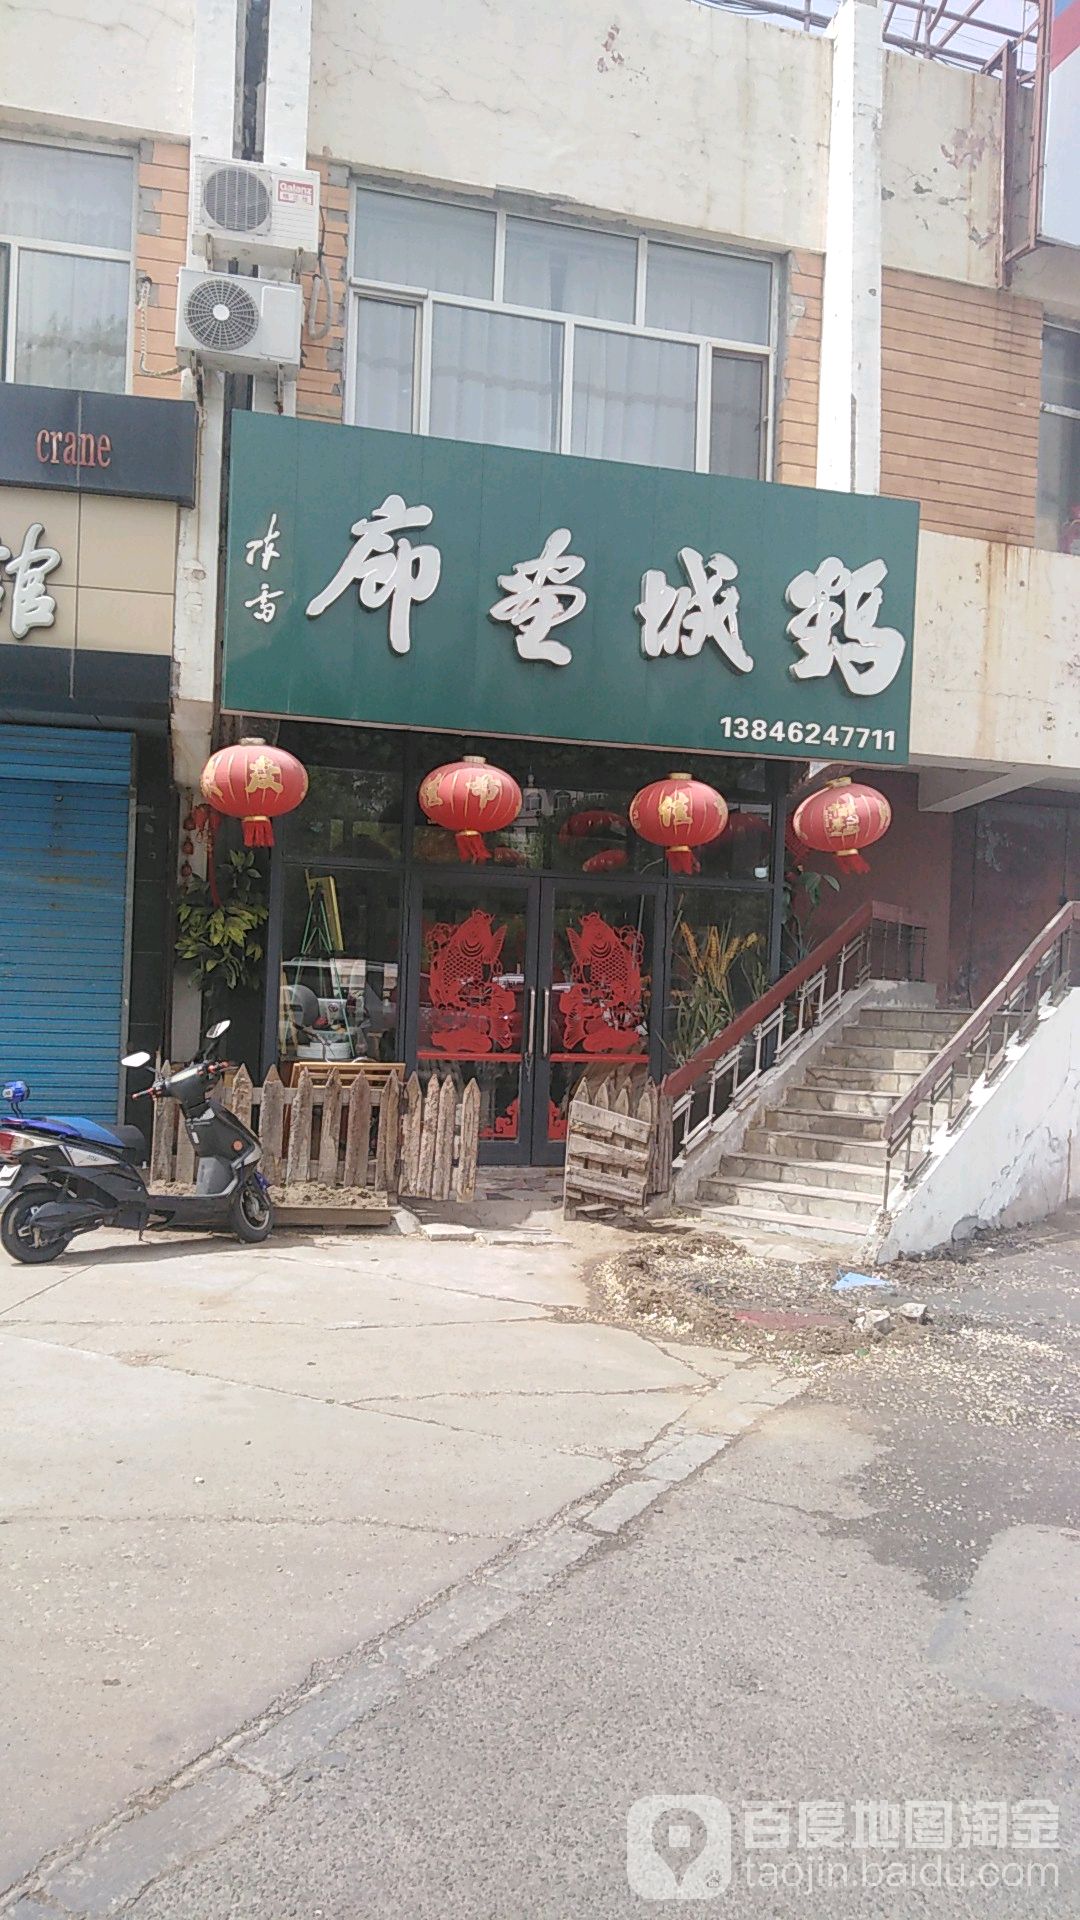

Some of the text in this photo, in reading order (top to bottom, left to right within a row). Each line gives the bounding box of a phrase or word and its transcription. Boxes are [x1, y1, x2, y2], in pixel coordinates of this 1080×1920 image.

[280, 182, 313, 195] Galanz
[36, 429, 111, 468] crane
[720, 716, 896, 751] 13846247711
